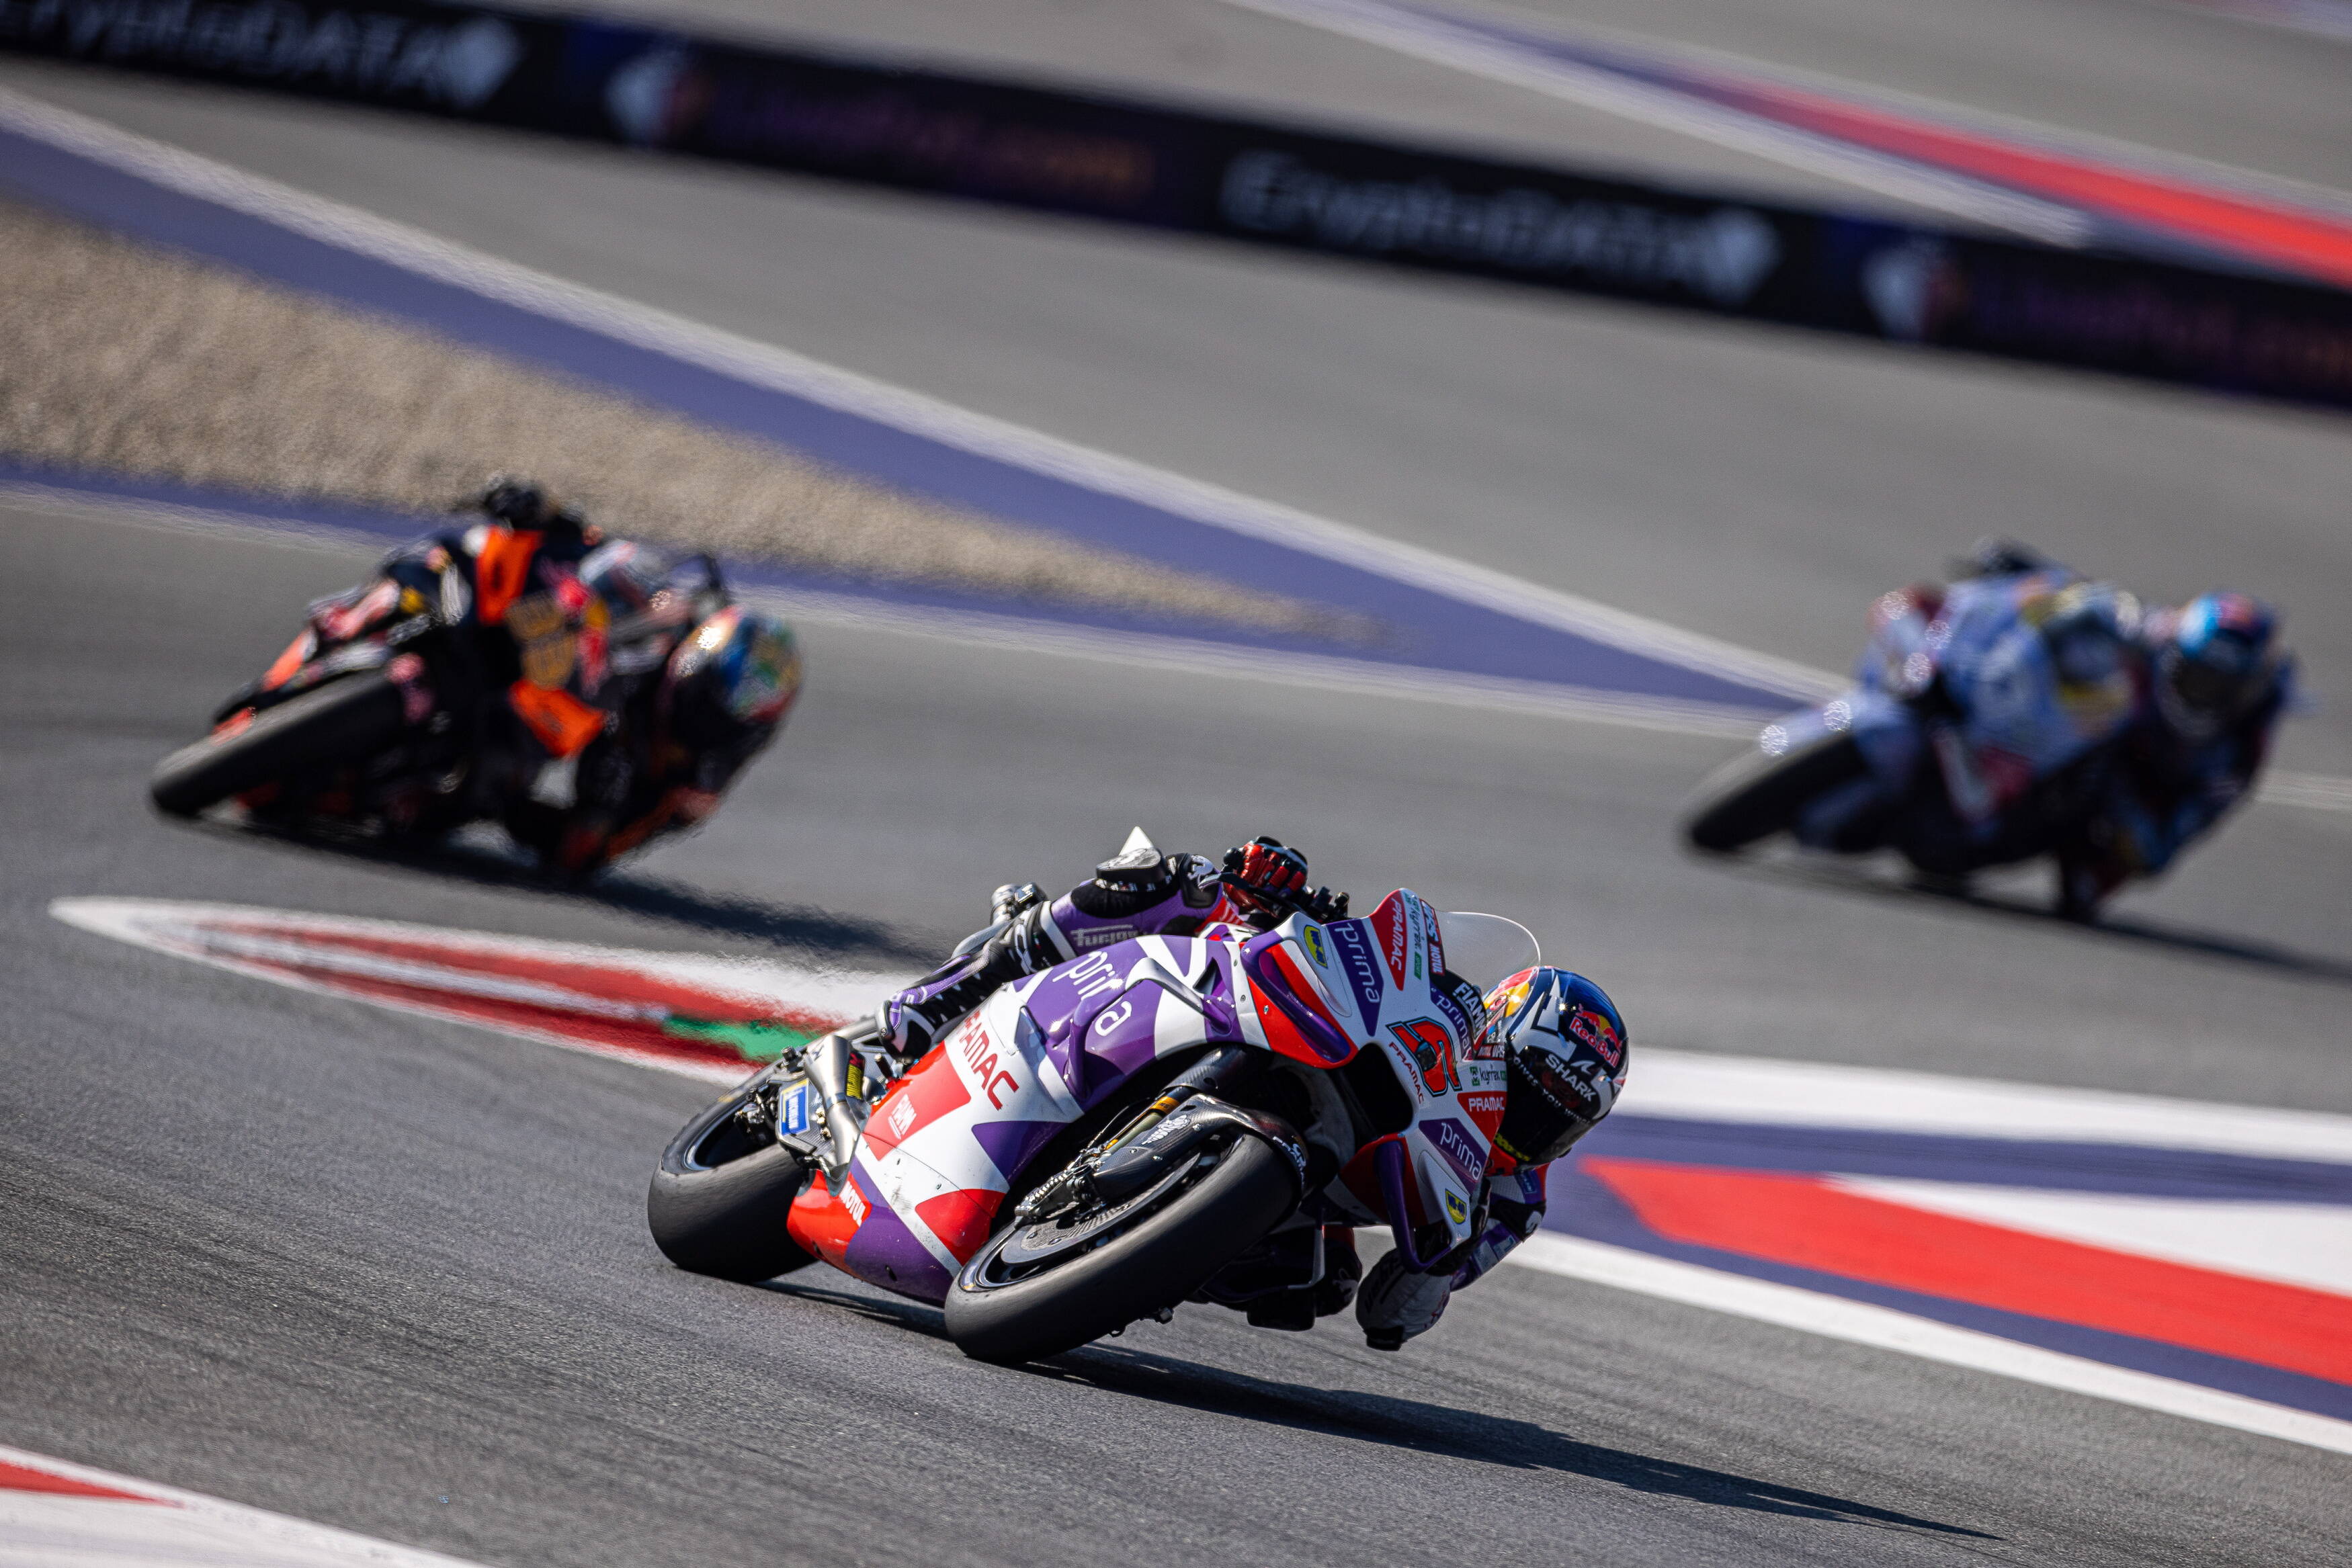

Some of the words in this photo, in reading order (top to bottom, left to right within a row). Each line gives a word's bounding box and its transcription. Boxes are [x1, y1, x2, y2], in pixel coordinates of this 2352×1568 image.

[1390, 897, 1404, 971] PRAMAC
[1430, 943, 1443, 973] MOTUL
[1335, 922, 1380, 1003] prima
[1437, 995, 1470, 1049] prima
[1569, 1016, 1597, 1047] Red
[1595, 1040, 1620, 1068] Bull
[1385, 1016, 1462, 1097] 5
[1389, 1042, 1424, 1104] PRAMAC
[1546, 1053, 1596, 1102] SHARK
[1468, 1096, 1505, 1113] PRAMAC
[1542, 1088, 1562, 1107] YOU
[1440, 1123, 1482, 1180] prima
[839, 1180, 866, 1227] MOTUL
